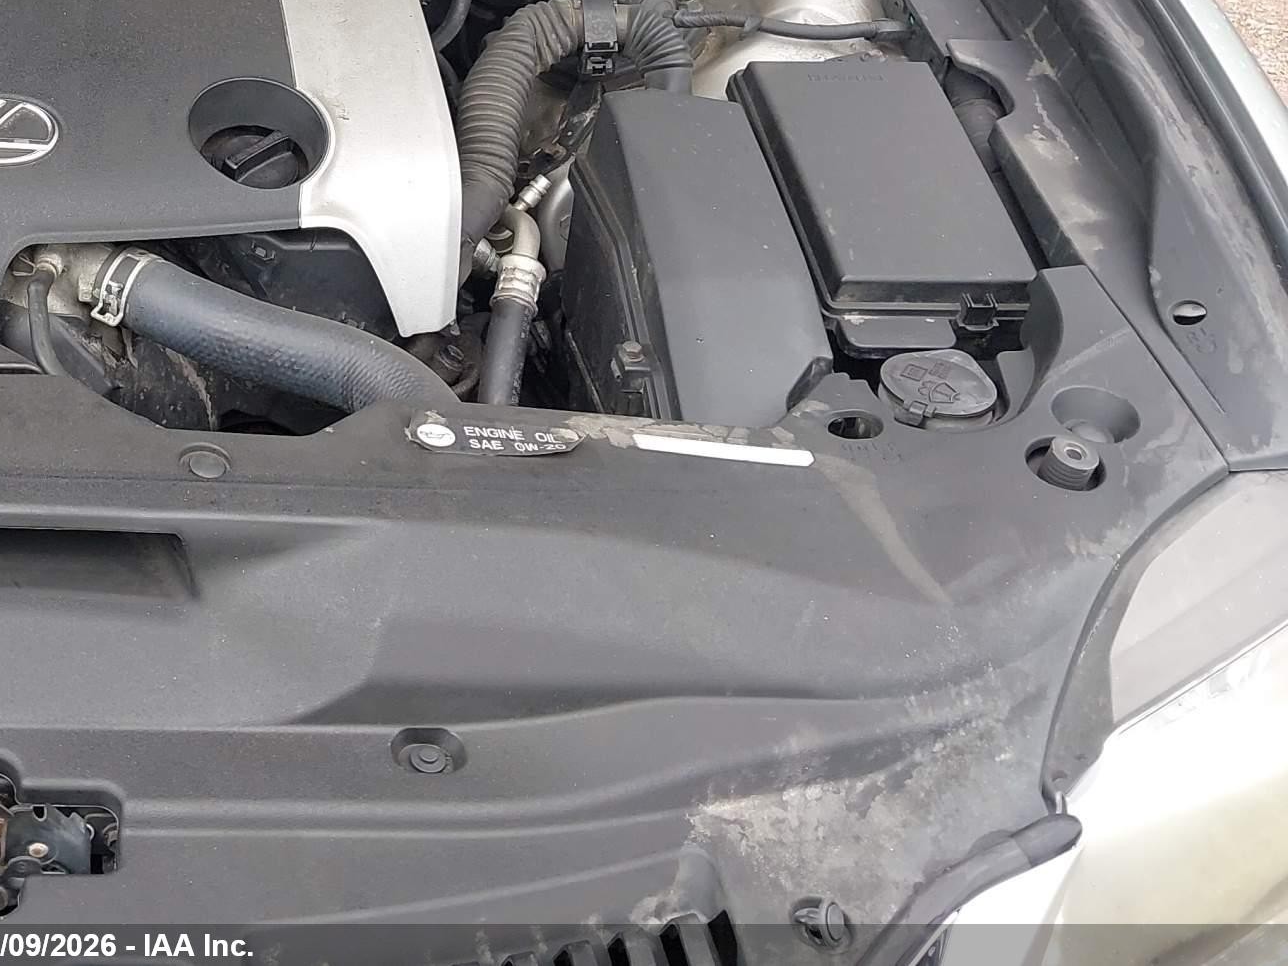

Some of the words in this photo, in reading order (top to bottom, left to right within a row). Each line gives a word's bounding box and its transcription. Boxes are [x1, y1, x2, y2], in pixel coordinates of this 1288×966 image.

[462, 425, 526, 441] ENGINE
[534, 432, 563, 444] OIL
[468, 438, 505, 451] SAE
[513, 441, 568, 452] 0W-20
